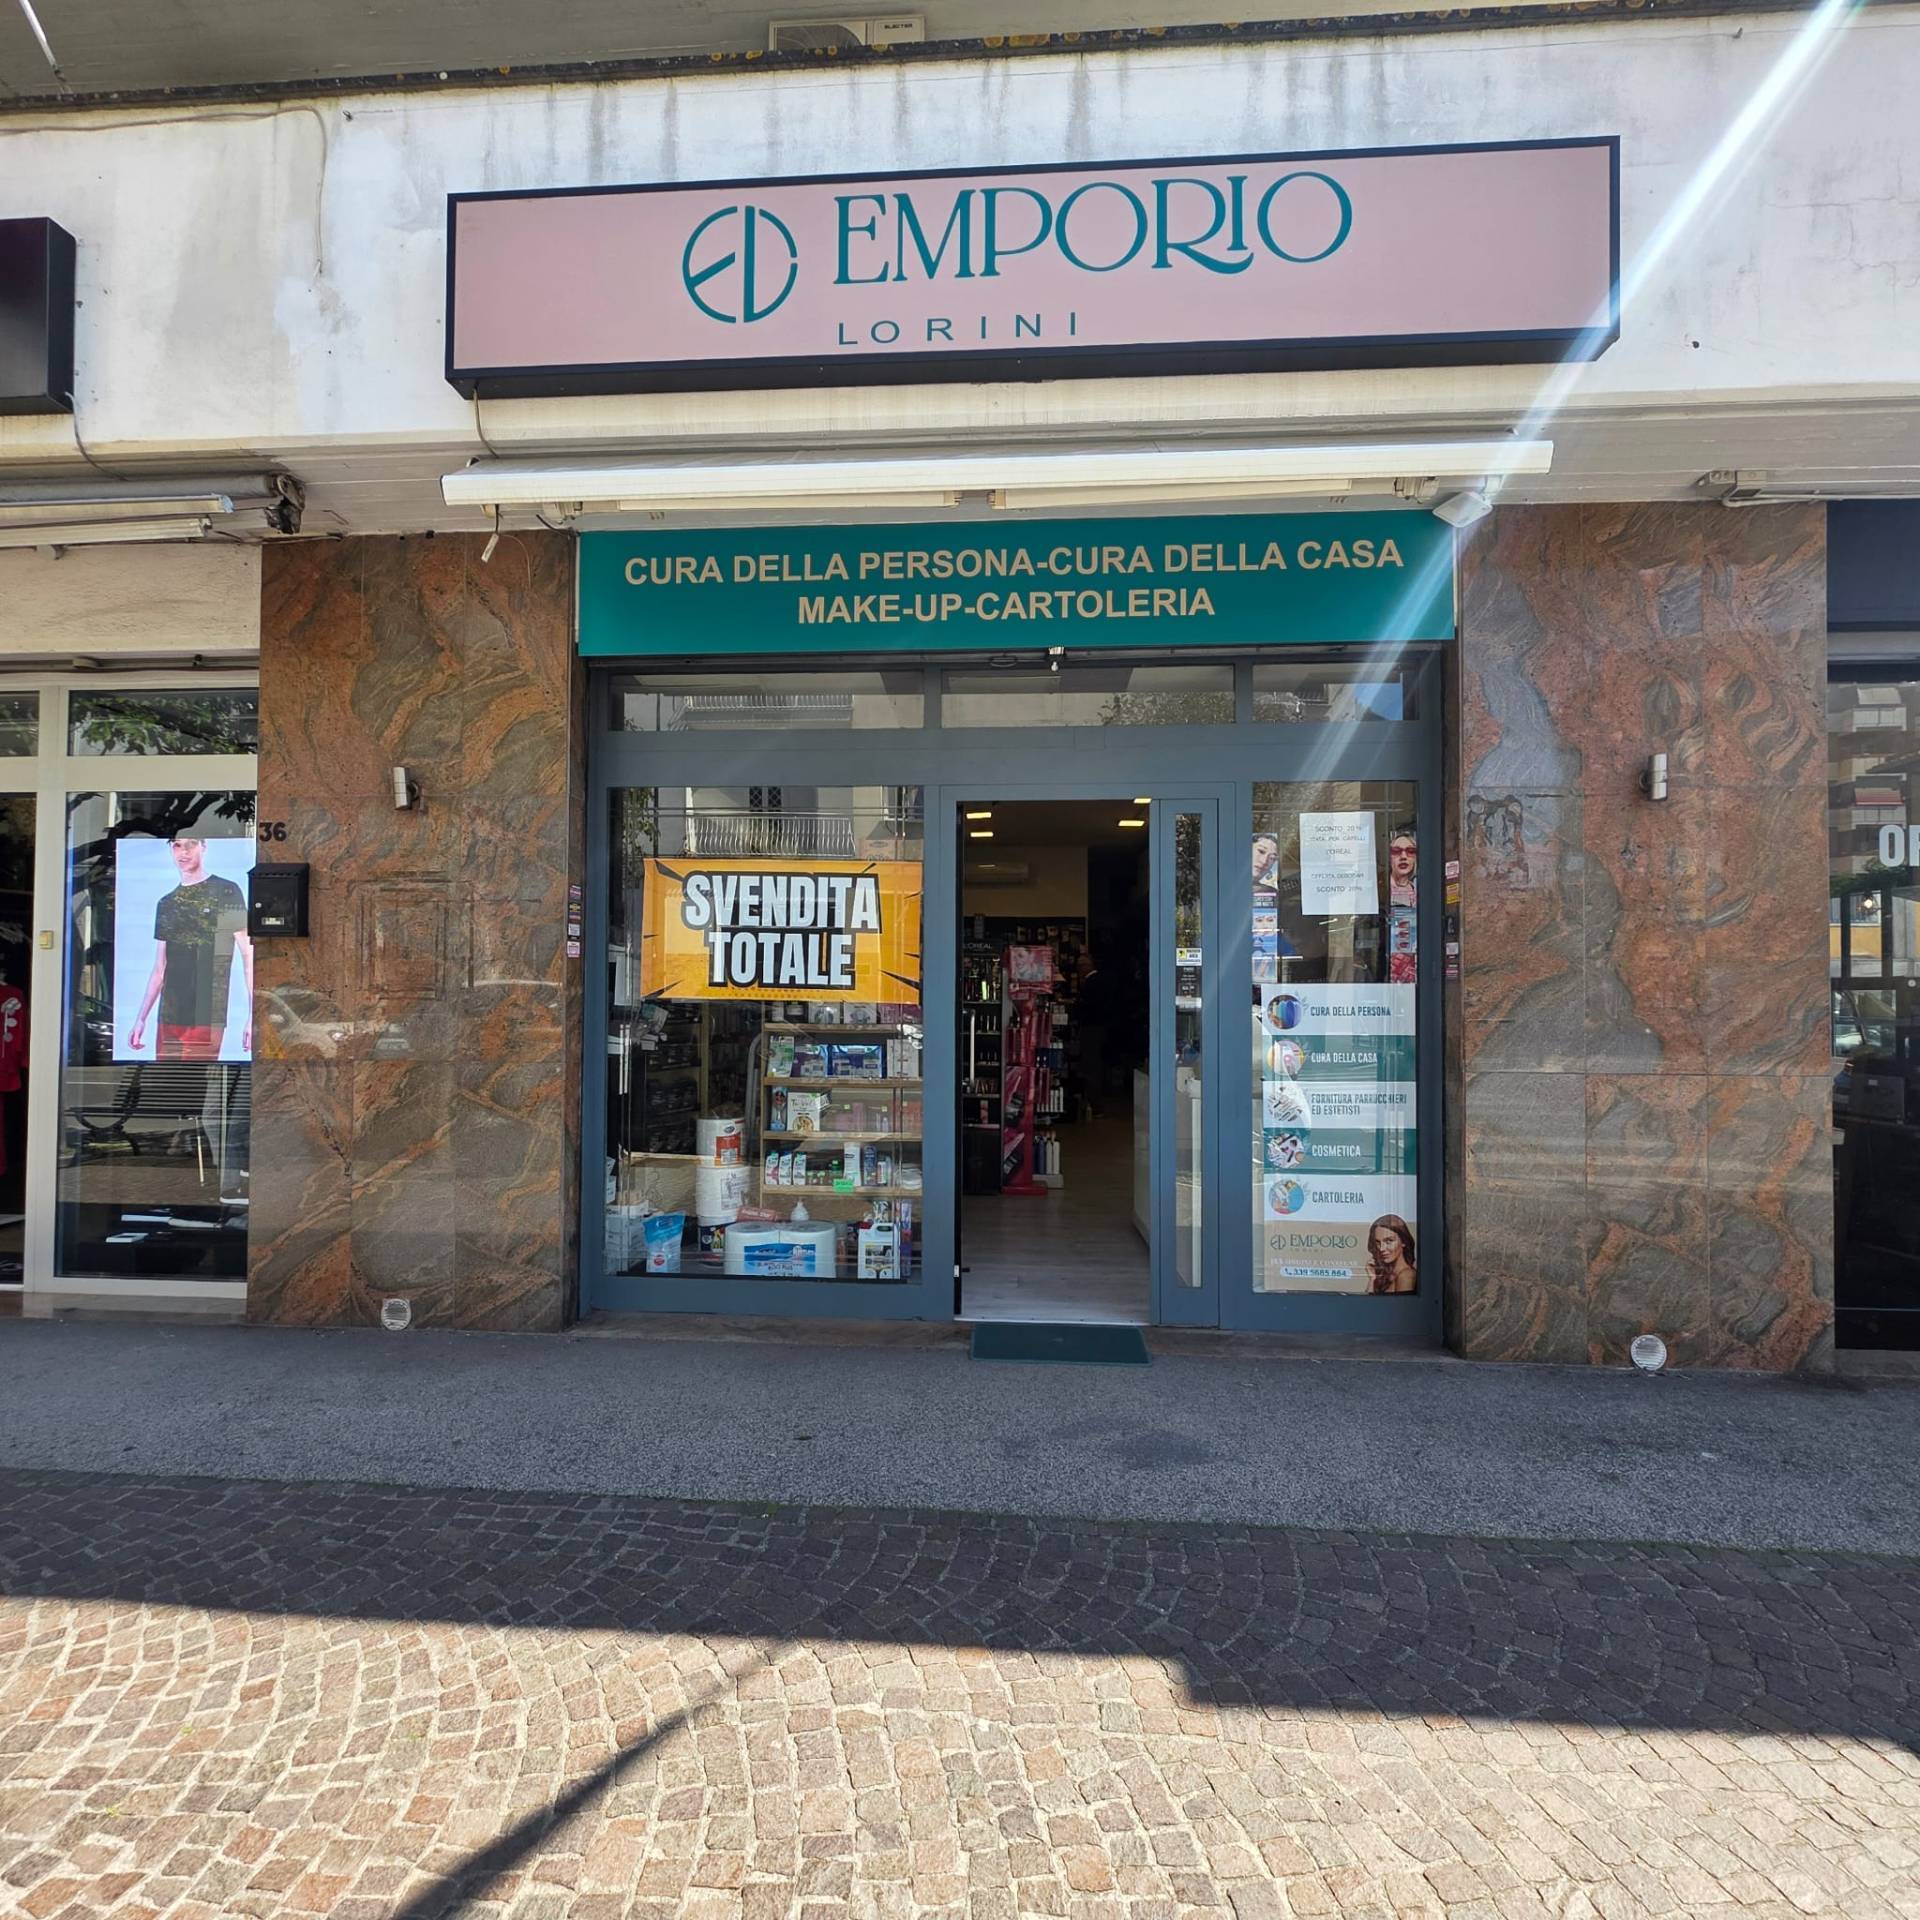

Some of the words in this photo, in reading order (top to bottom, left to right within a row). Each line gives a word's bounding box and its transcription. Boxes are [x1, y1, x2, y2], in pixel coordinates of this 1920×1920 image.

[833, 171, 1353, 285] EMPORIO
[838, 312, 1077, 346] LORINI
[624, 556, 724, 586] CURA
[733, 552, 849, 582] DELLA
[859, 545, 1154, 580] PERSONA-CURA
[1164, 542, 1288, 573] DELLA
[1297, 539, 1404, 569] CASA
[798, 588, 1215, 625] MAKE-UP-CARTOLERIA
[259, 822, 287, 842] 36
[684, 873, 880, 930] SVENDITA
[708, 931, 853, 986] TOTALE
[1310, 1006, 1330, 1016] CURA
[1332, 1006, 1356, 1016] DELLA
[1358, 1006, 1391, 1016] PERSONA
[1311, 1053, 1331, 1063] CURA
[1333, 1053, 1356, 1063] DELLA
[1358, 1053, 1378, 1063] CASA
[1311, 1094, 1353, 1104] FORNITURA
[1355, 1094, 1407, 1104] PARRUCCHIERI
[1311, 1105, 1322, 1115] ED
[1323, 1105, 1360, 1115] ESTETISTI
[1312, 1145, 1361, 1157] COSMETICA
[1312, 1191, 1364, 1204] CARTOLERIA
[1290, 1234, 1358, 1249] EMPORIO
